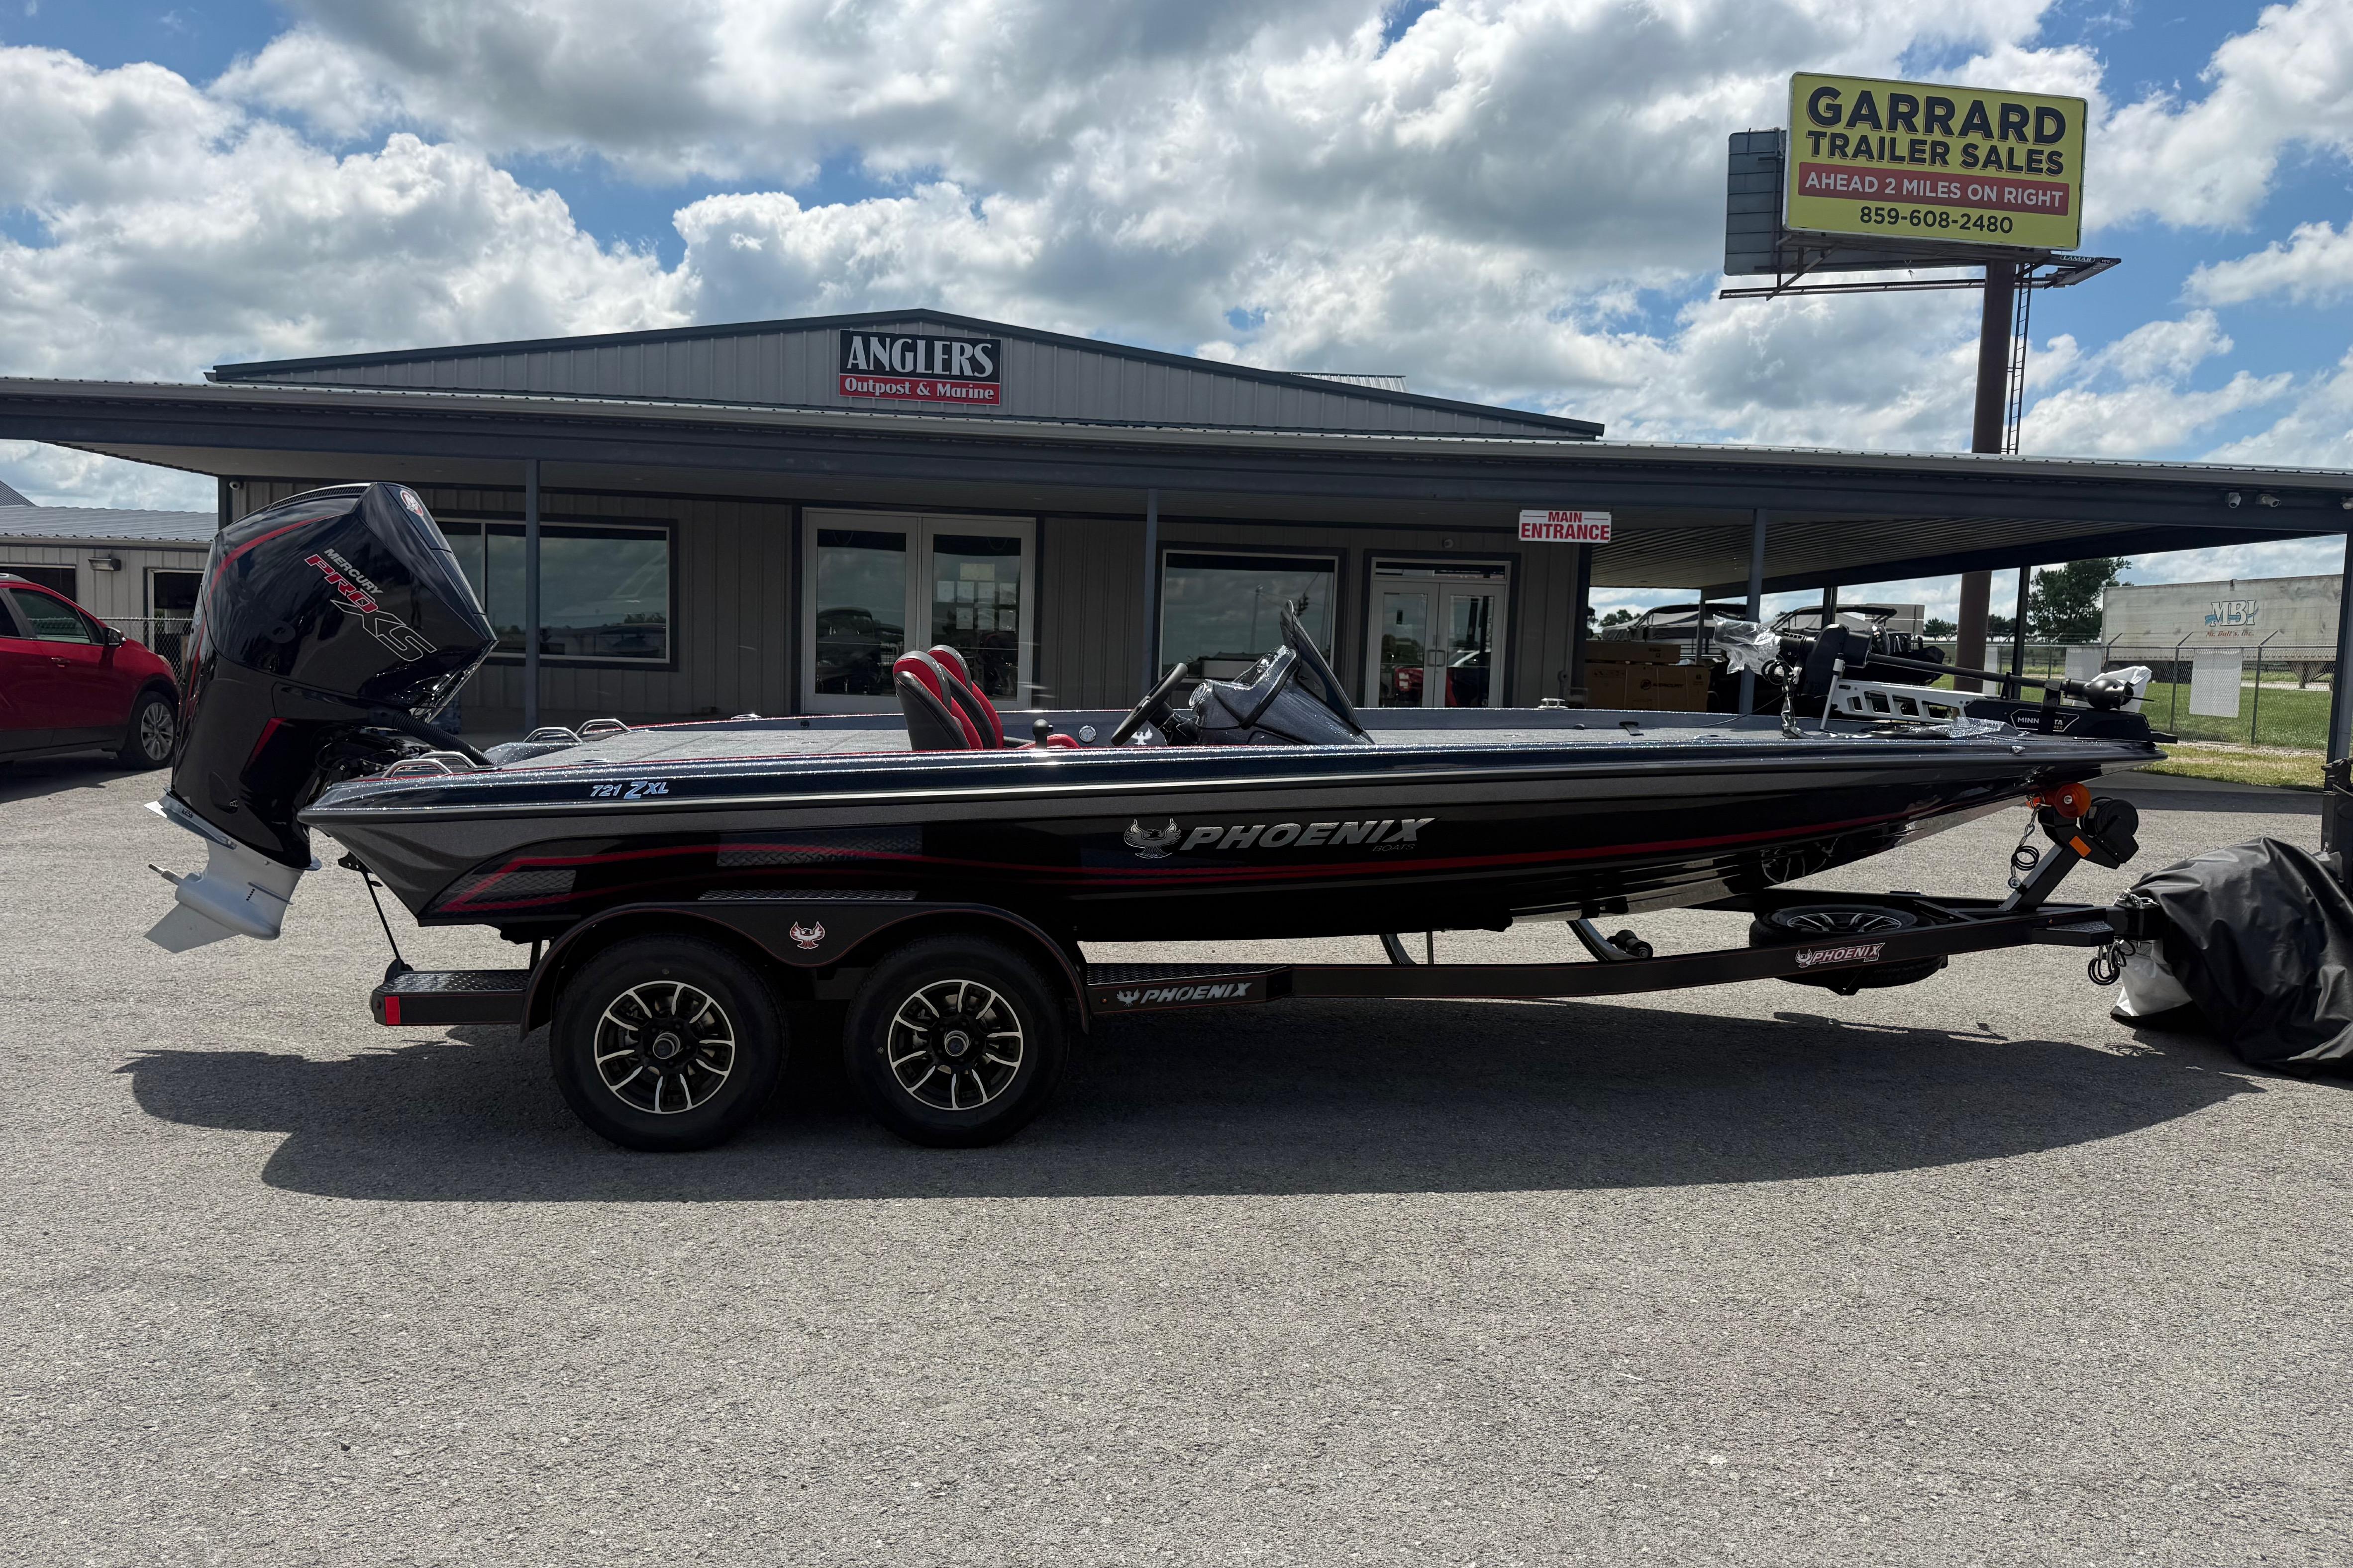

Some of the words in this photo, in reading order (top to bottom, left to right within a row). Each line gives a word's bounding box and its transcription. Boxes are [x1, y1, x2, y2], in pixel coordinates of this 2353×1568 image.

[1806, 86, 2066, 145] GARRARD
[1806, 130, 1950, 167] TRAILER
[1960, 143, 2064, 176] SALES
[1805, 171, 1878, 193] AHEAD
[1885, 178, 1896, 194] 2
[1903, 180, 1961, 199] MILES
[1967, 184, 1997, 202] ON
[2004, 186, 2063, 207] RIGHT
[1860, 206, 2014, 234] 859-608-2480
[846, 336, 994, 377] ANGLERS
[845, 378, 912, 396] Outpost
[917, 382, 931, 396] &
[936, 383, 994, 399] Marine
[1548, 511, 1582, 523] MAIN
[1521, 523, 1610, 540] ENTRANCE
[304, 554, 378, 613] PRO
[324, 548, 383, 594] MERCURY
[2210, 600, 2256, 627] MBI
[590, 784, 622, 797] 721
[1179, 818, 1435, 850] PHOENIX
[1811, 945, 1882, 963] PHOENIX
[1140, 982, 1253, 1004] PHOENIX
